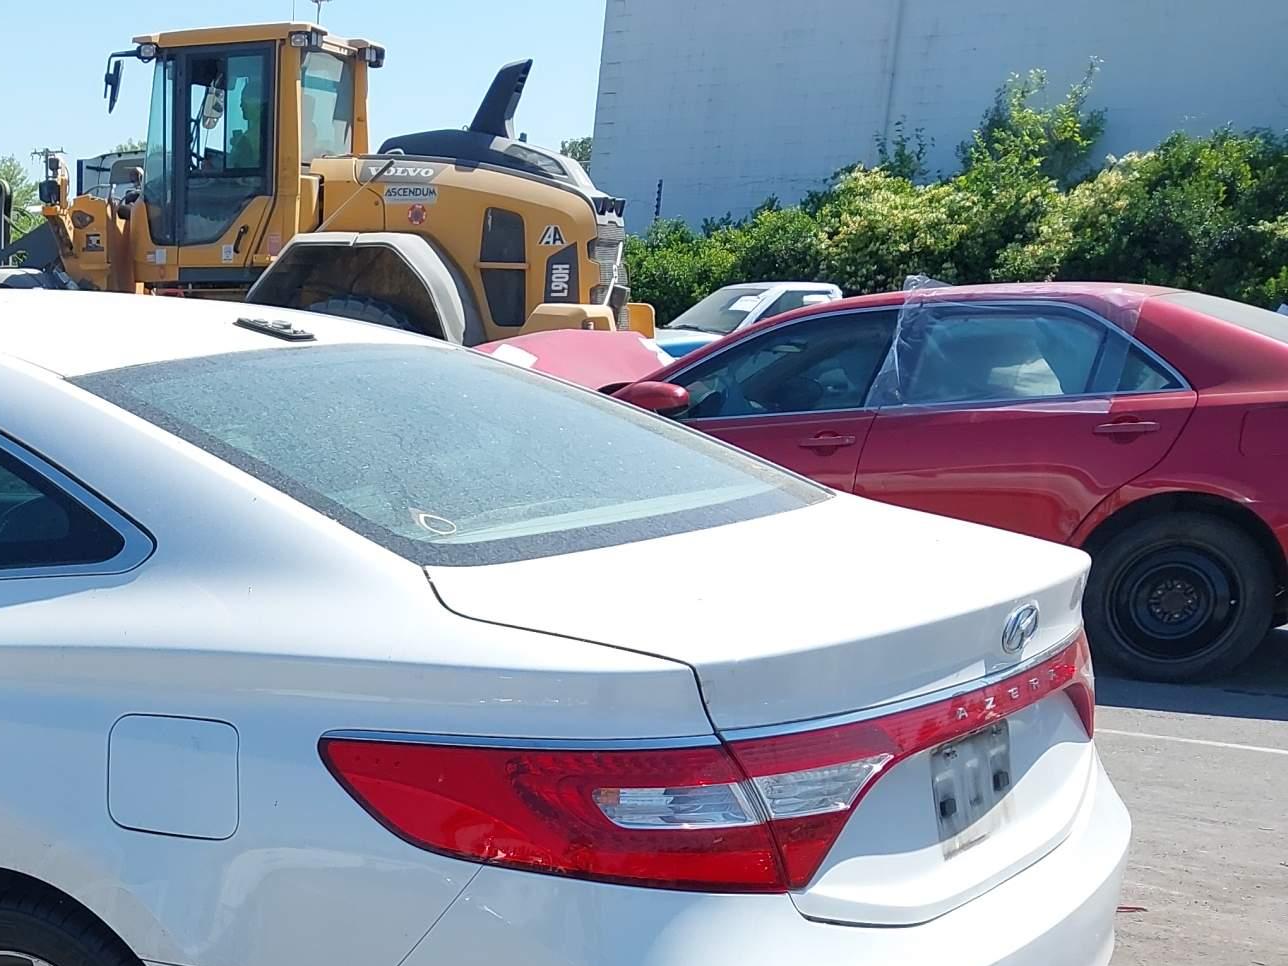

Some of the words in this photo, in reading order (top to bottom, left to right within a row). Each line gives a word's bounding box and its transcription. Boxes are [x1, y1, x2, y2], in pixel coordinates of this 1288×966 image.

[368, 166, 434, 177] VOLVO
[384, 187, 437, 197] ASCENDUM
[550, 264, 570, 297] L90H
